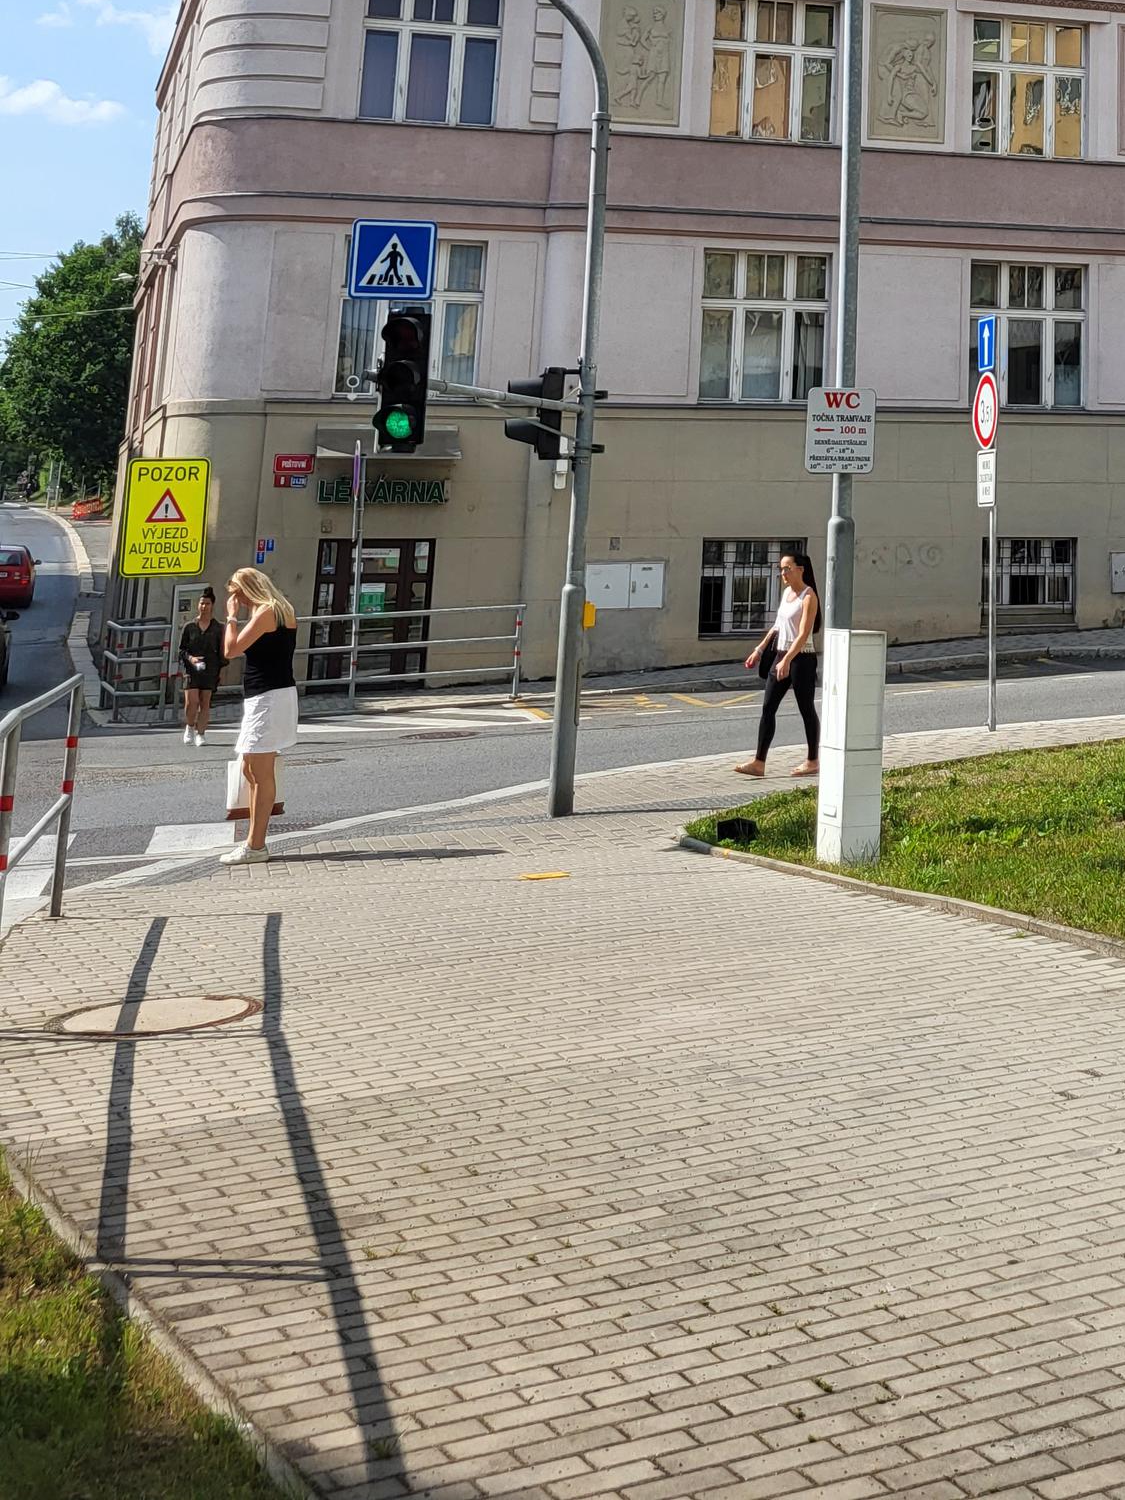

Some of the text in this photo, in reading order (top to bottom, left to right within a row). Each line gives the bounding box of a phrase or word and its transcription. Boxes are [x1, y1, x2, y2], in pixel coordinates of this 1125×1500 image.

[824, 392, 860, 409] WC
[812, 413, 834, 422] TOČNA
[840, 426, 856, 434] 100
[138, 466, 200, 482] POZOR
[142, 525, 189, 540] VÝJEZD
[129, 538, 199, 555] AUTOBUSŮ
[141, 557, 182, 570] ZLEVA
